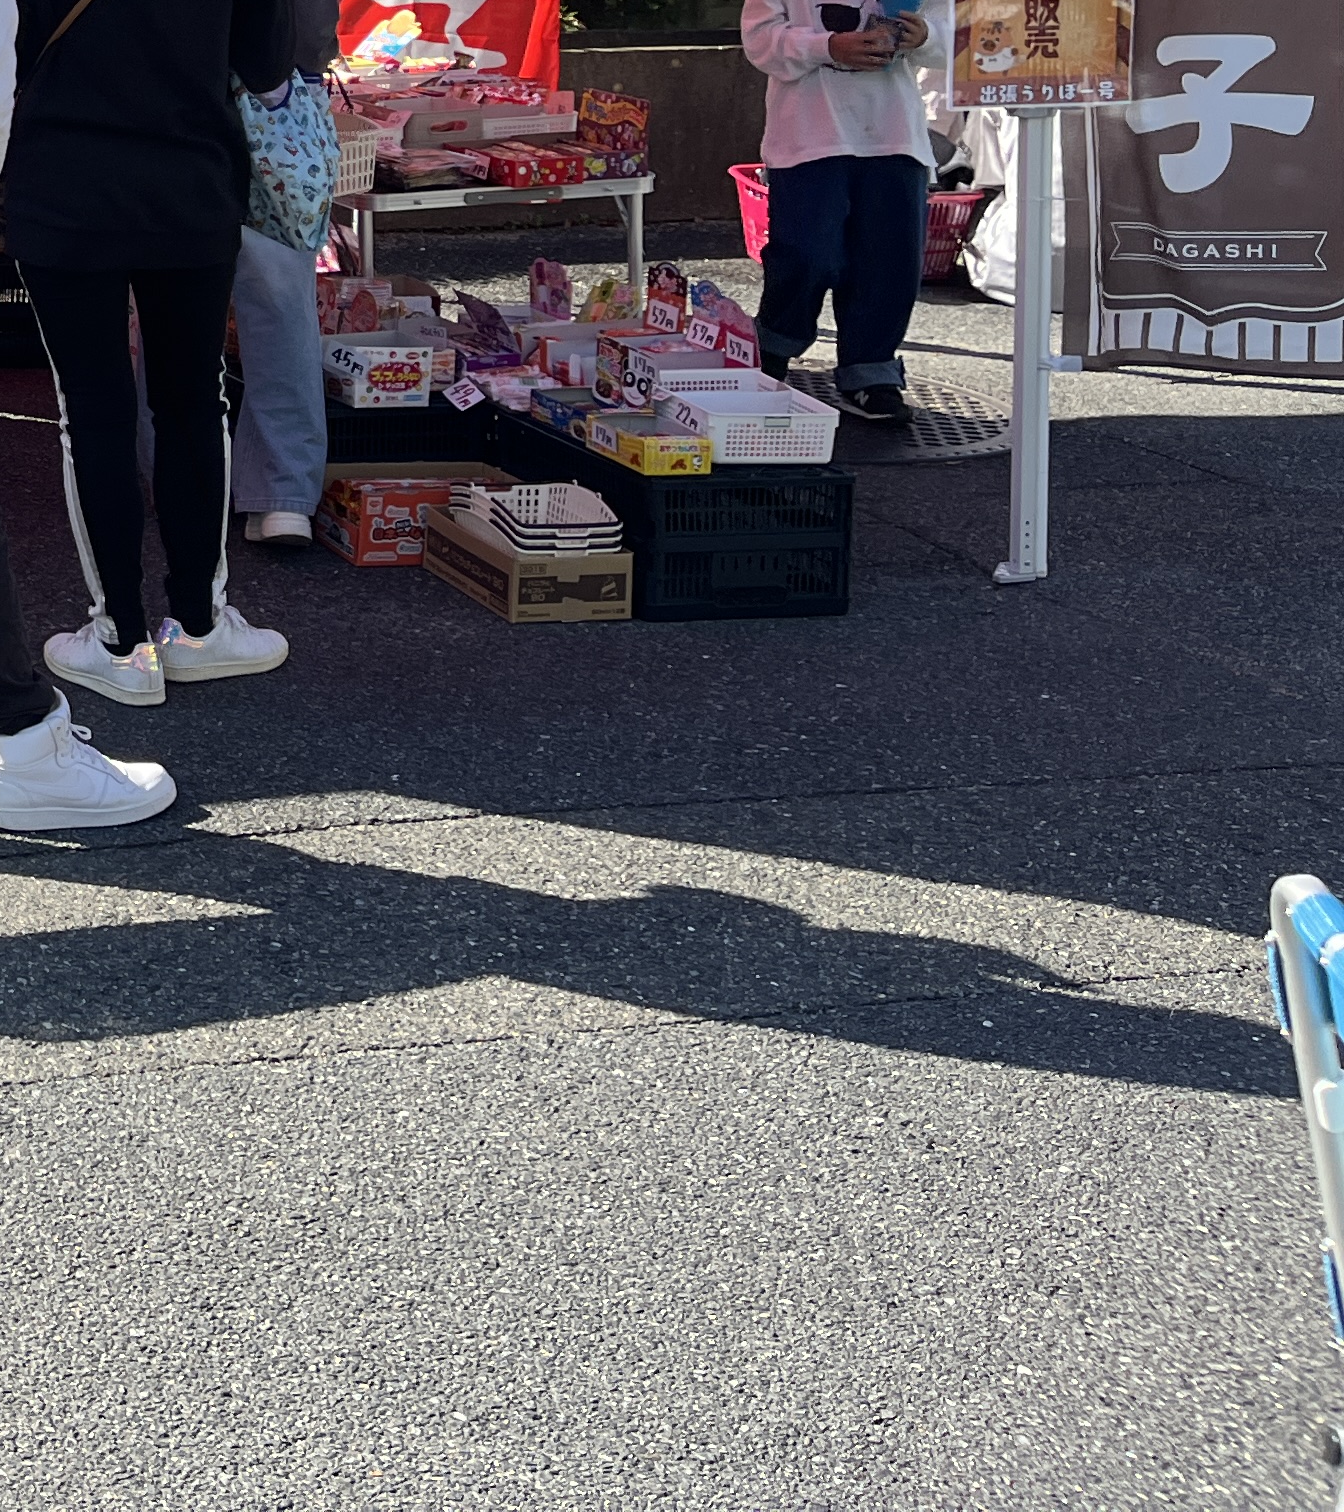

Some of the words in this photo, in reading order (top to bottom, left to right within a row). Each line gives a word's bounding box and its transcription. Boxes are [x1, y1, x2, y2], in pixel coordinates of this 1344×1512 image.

[979, 81, 1115, 103] 出張うりぼー号
[1153, 237, 1279, 259] DAGASHI
